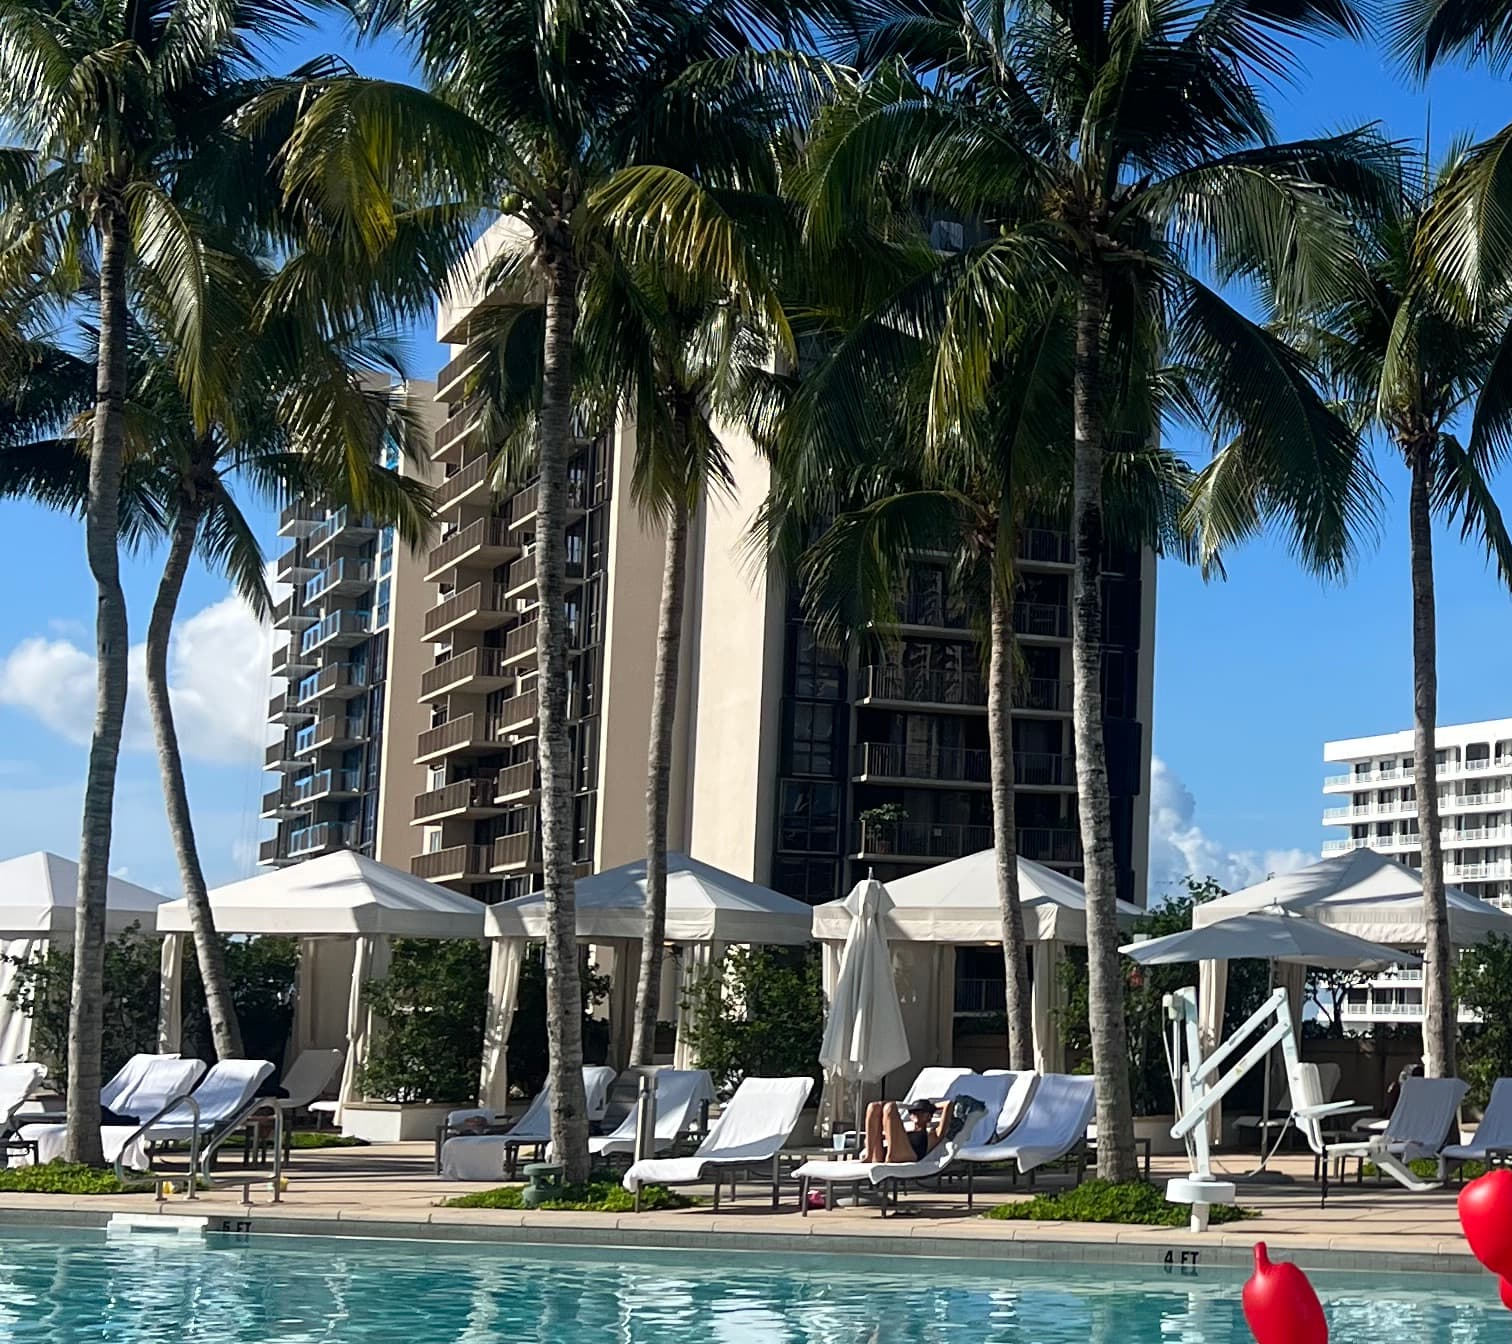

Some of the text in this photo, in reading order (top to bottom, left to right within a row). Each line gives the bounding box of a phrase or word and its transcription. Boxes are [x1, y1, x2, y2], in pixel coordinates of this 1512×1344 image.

[236, 1221, 252, 1233] FT
[1164, 1250, 1199, 1265] 4 FT
